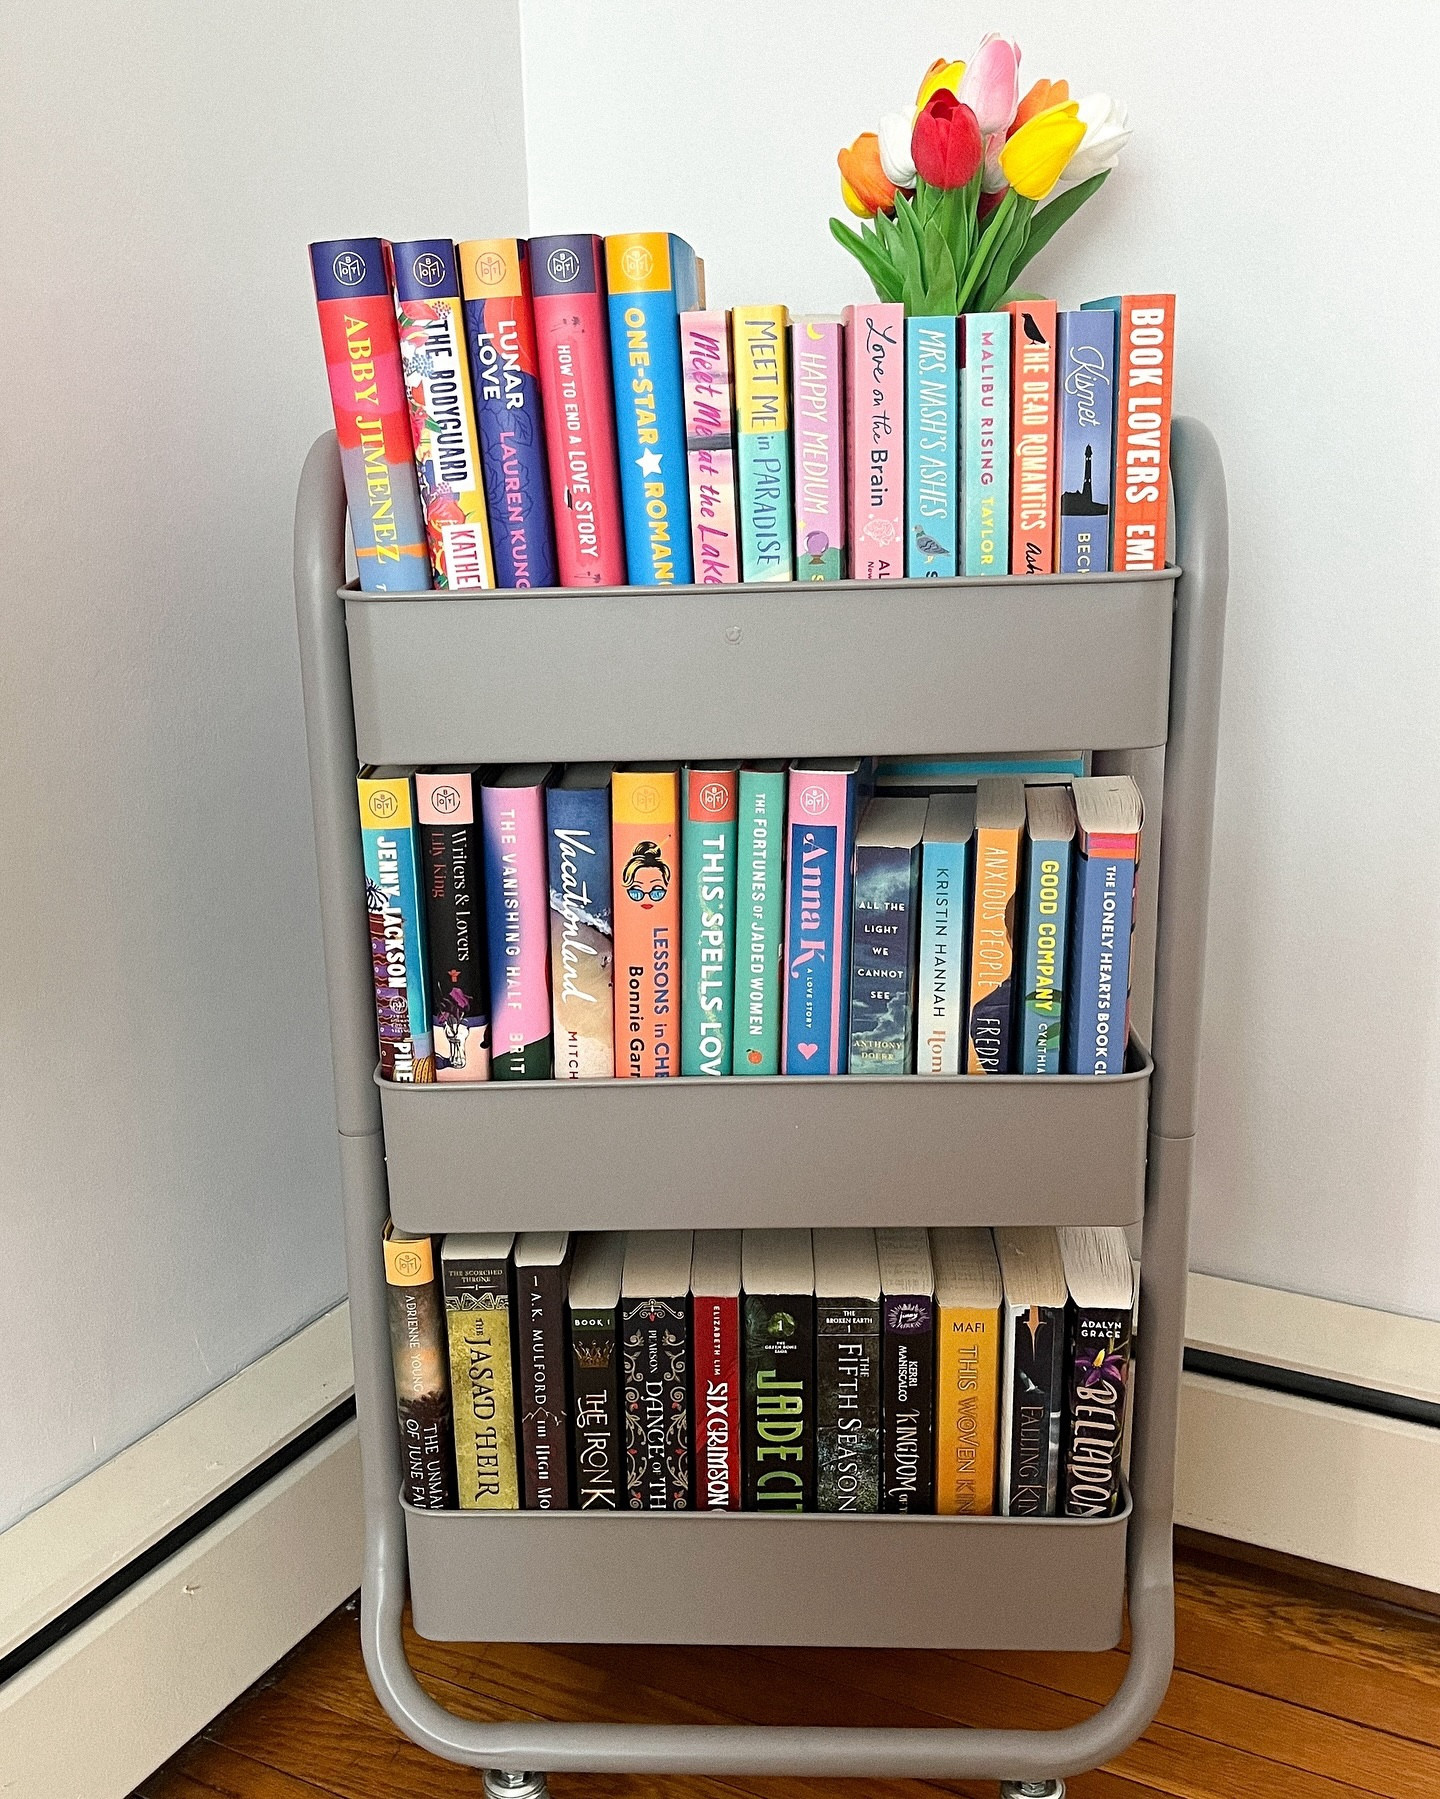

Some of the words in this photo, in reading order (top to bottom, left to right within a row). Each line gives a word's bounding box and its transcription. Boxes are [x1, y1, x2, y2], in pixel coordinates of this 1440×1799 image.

[343, 314, 381, 406] ABBY
[424, 319, 453, 357] THE
[557, 345, 573, 377] HOW
[689, 331, 722, 395] Meet
[745, 320, 779, 385] MEET
[866, 317, 897, 383] Love
[918, 328, 947, 375] MRS.
[1023, 341, 1049, 373] THE
[1128, 308, 1165, 387] BOOK
[478, 333, 501, 401] LOVE
[497, 320, 524, 410] LUNAR
[561, 383, 576, 399] TO
[624, 307, 659, 444] ONE-STAR
[800, 351, 828, 422] HAPPY
[981, 332, 994, 408] MALIBU
[1064, 345, 1110, 427] Kismet
[564, 403, 580, 432] END
[693, 400, 721, 437] Me
[751, 395, 779, 428] ME
[872, 389, 884, 407] on
[919, 380, 948, 452] NASH'S
[1021, 381, 1049, 426] DEAD
[429, 369, 468, 482] BODYGUARD
[569, 436, 582, 444] A
[756, 436, 774, 450] in
[872, 410, 892, 444] the
[1125, 397, 1162, 504] LOVERS
[500, 431, 525, 522] LAUREN
[568, 451, 591, 494] LOVE
[698, 449, 719, 475] at
[803, 431, 829, 515] MEDIUM
[871, 449, 888, 507] Brain
[980, 418, 994, 486] RISING
[355, 415, 401, 564] JIMENEZ
[699, 484, 721, 517] the
[753, 458, 781, 566] PARADISE
[919, 455, 948, 520] ASHES
[575, 500, 599, 558] STORY
[980, 497, 994, 565] TAYLOR
[1125, 524, 1155, 571] EMI
[500, 809, 516, 844] THE
[755, 794, 766, 815] THE
[376, 835, 400, 895] JENNY
[430, 831, 444, 858] Lily
[450, 829, 467, 890] Writers
[701, 834, 725, 901] THIS
[752, 819, 767, 901] FORTUNES
[432, 863, 446, 899] King
[454, 894, 470, 905] &
[801, 832, 829, 931] Anna
[935, 868, 949, 936] KRISTIN
[982, 847, 1009, 920] ANXIOUS
[1039, 860, 1059, 915] GOOD
[1105, 865, 1117, 888] THE
[502, 853, 520, 957] VANISHING
[554, 828, 597, 1004] Vacationland
[754, 905, 763, 918] OF
[859, 902, 880, 910] ALL
[885, 902, 905, 911] THE
[864, 925, 898, 934] LIGHT
[1100, 892, 1116, 949] LONELY
[383, 904, 407, 988] JACKSON
[456, 911, 470, 962] Lovers
[751, 922, 765, 974] JADED
[791, 940, 826, 978] K
[872, 948, 889, 956] WE
[977, 928, 1003, 988] PEOPLE
[506, 964, 522, 1010] HALF
[653, 927, 670, 1015] LESSONS
[700, 915, 725, 1011] SPELLS
[857, 968, 904, 978] CANNOT
[933, 944, 946, 1017] HANNAH
[1035, 922, 1057, 1011] COMPANY
[1097, 951, 1113, 1009] HEARTS
[628, 966, 645, 1032] Bonnie
[749, 977, 763, 1035] WOMEN
[870, 990, 891, 1000] SEE
[508, 1032, 525, 1074] BRIT
[655, 1023, 669, 1034] in
[853, 1040, 902, 1049] ANTHONY
[1095, 1013, 1110, 1058] BOOK
[568, 1031, 579, 1079] MITCH
[862, 1052, 894, 1060] DOERR
[405, 1295, 420, 1349] ADRIENNE
[531, 1293, 543, 1321] A.K.
[777, 1320, 783, 1331] 1
[952, 1323, 984, 1332] MAFI
[1081, 1321, 1122, 1329] ADALYN
[649, 1330, 658, 1373] PEARSON
[1081, 1330, 1121, 1338] GRACE
[412, 1352, 422, 1393] YOUNG
[463, 1336, 496, 1420] JASAD
[533, 1329, 547, 1405] MULFORD
[838, 1344, 862, 1409] FIFTH
[860, 1357, 870, 1378] THE
[898, 1346, 907, 1402] MANISCALCO
[909, 1361, 918, 1387] KERRI
[958, 1346, 979, 1391] THIS
[577, 1390, 608, 1428] THE
[641, 1381, 664, 1459] DANCE
[707, 1380, 728, 1417] SIX
[756, 1370, 803, 1462] JADE
[405, 1418, 420, 1440] OF
[423, 1423, 439, 1455] THE
[889, 1408, 921, 1496] KINGDOM
[956, 1396, 979, 1473] WOVEN
[1018, 1406, 1044, 1478] FALLING
[407, 1443, 423, 1480] JUNE
[475, 1427, 501, 1502] HEIR
[535, 1445, 550, 1480] HIGH
[580, 1432, 613, 1483] IRON
[706, 1420, 729, 1506] CRIMSON
[837, 1418, 862, 1511] SEASON
[580, 1489, 616, 1510] K
